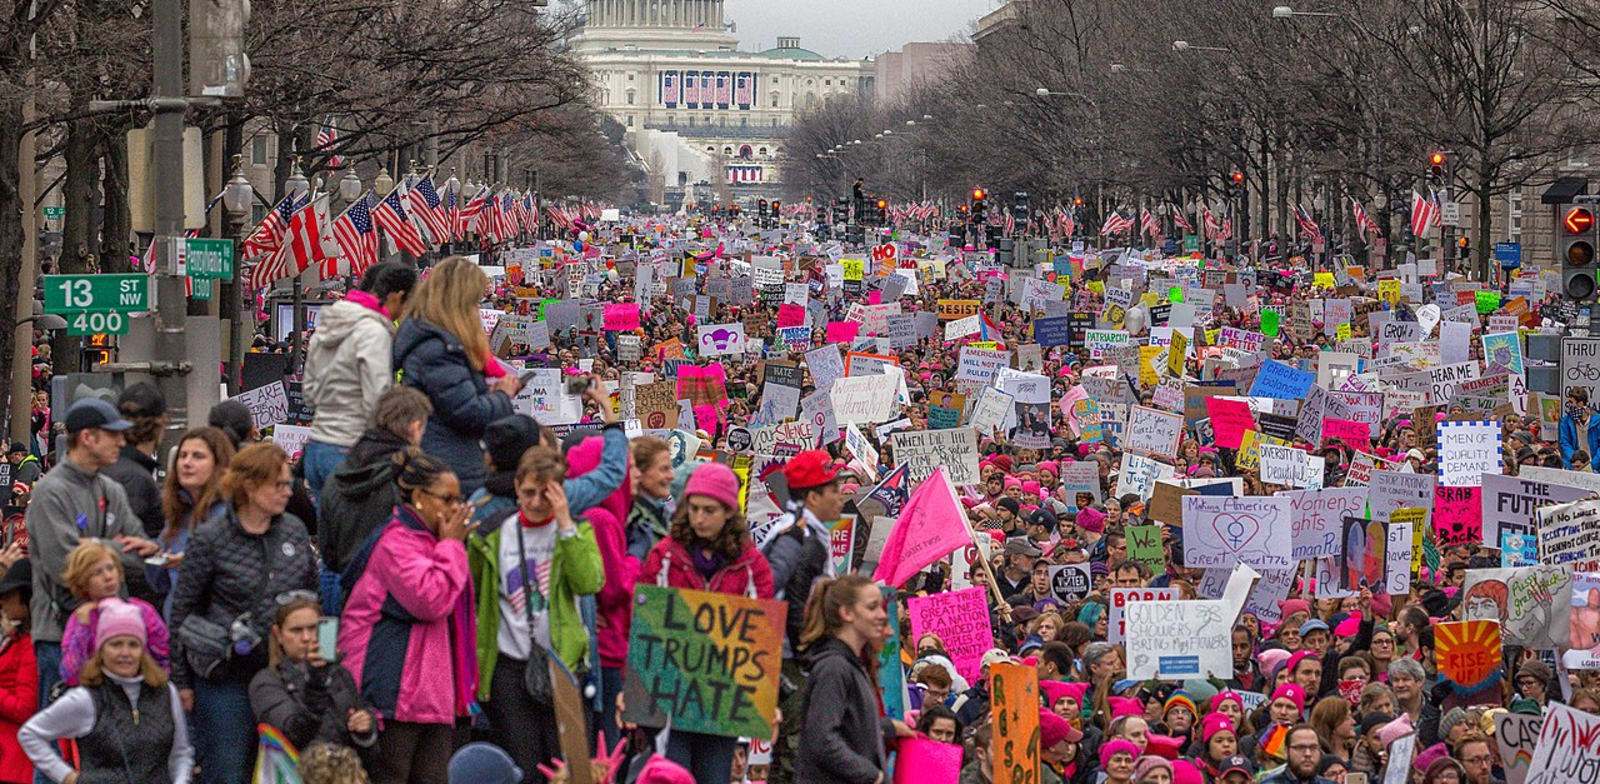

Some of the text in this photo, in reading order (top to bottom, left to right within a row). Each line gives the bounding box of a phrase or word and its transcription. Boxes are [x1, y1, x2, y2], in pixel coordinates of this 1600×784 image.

[873, 243, 895, 260] HO
[59, 279, 139, 307] 13 ST
[120, 294, 141, 305] NW
[939, 305, 979, 314] RESIST
[1354, 303, 1381, 315] LOVE
[73, 313, 122, 331] 400
[1087, 331, 1128, 343] PATRIARCHY
[1221, 328, 1264, 343] WE ARE
[965, 349, 1006, 359] AMERICANS
[1567, 344, 1597, 357] THRU
[963, 358, 980, 366] WILL
[981, 361, 995, 369] NOT
[966, 369, 990, 377] RULED
[1430, 365, 1472, 383] HEAR ME
[1460, 376, 1500, 391] WOMEN
[257, 383, 282, 403] ARE
[1478, 398, 1497, 410] WILL
[253, 405, 288, 429] TORM
[775, 423, 813, 441] SILENCE
[1325, 420, 1366, 436] ETHICS
[894, 433, 925, 448] WHEN
[928, 432, 945, 446] DID
[1446, 433, 1489, 444] MEN OF
[895, 444, 947, 458] DOLLAR
[1260, 444, 1304, 463] DIVERSITY IS
[1446, 449, 1490, 461] QUALITY
[1128, 454, 1161, 480] Liberty
[1446, 462, 1490, 472] DEMAND
[1378, 474, 1398, 485] STOP
[1400, 475, 1428, 490] TRYING
[1448, 475, 1482, 485] WOME
[1436, 487, 1473, 501] GRAB
[1520, 481, 1550, 496] THE
[1187, 497, 1281, 513] Making America
[1543, 515, 1554, 527] AM
[1557, 513, 1571, 522] NO
[1573, 508, 1598, 520] LONGER
[1131, 530, 1156, 550] We
[1547, 539, 1575, 555] CANNOT
[1186, 549, 1233, 565] GREAT
[1262, 555, 1289, 566] 1776
[1588, 544, 1600, 558] TH
[1063, 568, 1076, 577] END
[931, 591, 981, 607] THE TRUE
[921, 598, 985, 620] GREATNESS
[1128, 603, 1186, 625] GOLDEN
[664, 594, 765, 644] LOVE
[922, 610, 986, 631] OF A NATION
[975, 631, 986, 642] OF
[1130, 622, 1192, 639] SHOWERS
[1131, 637, 1170, 651] BRING
[637, 632, 770, 682] TRUMPS
[1450, 651, 1486, 669] RISE
[648, 676, 757, 722] HATE
